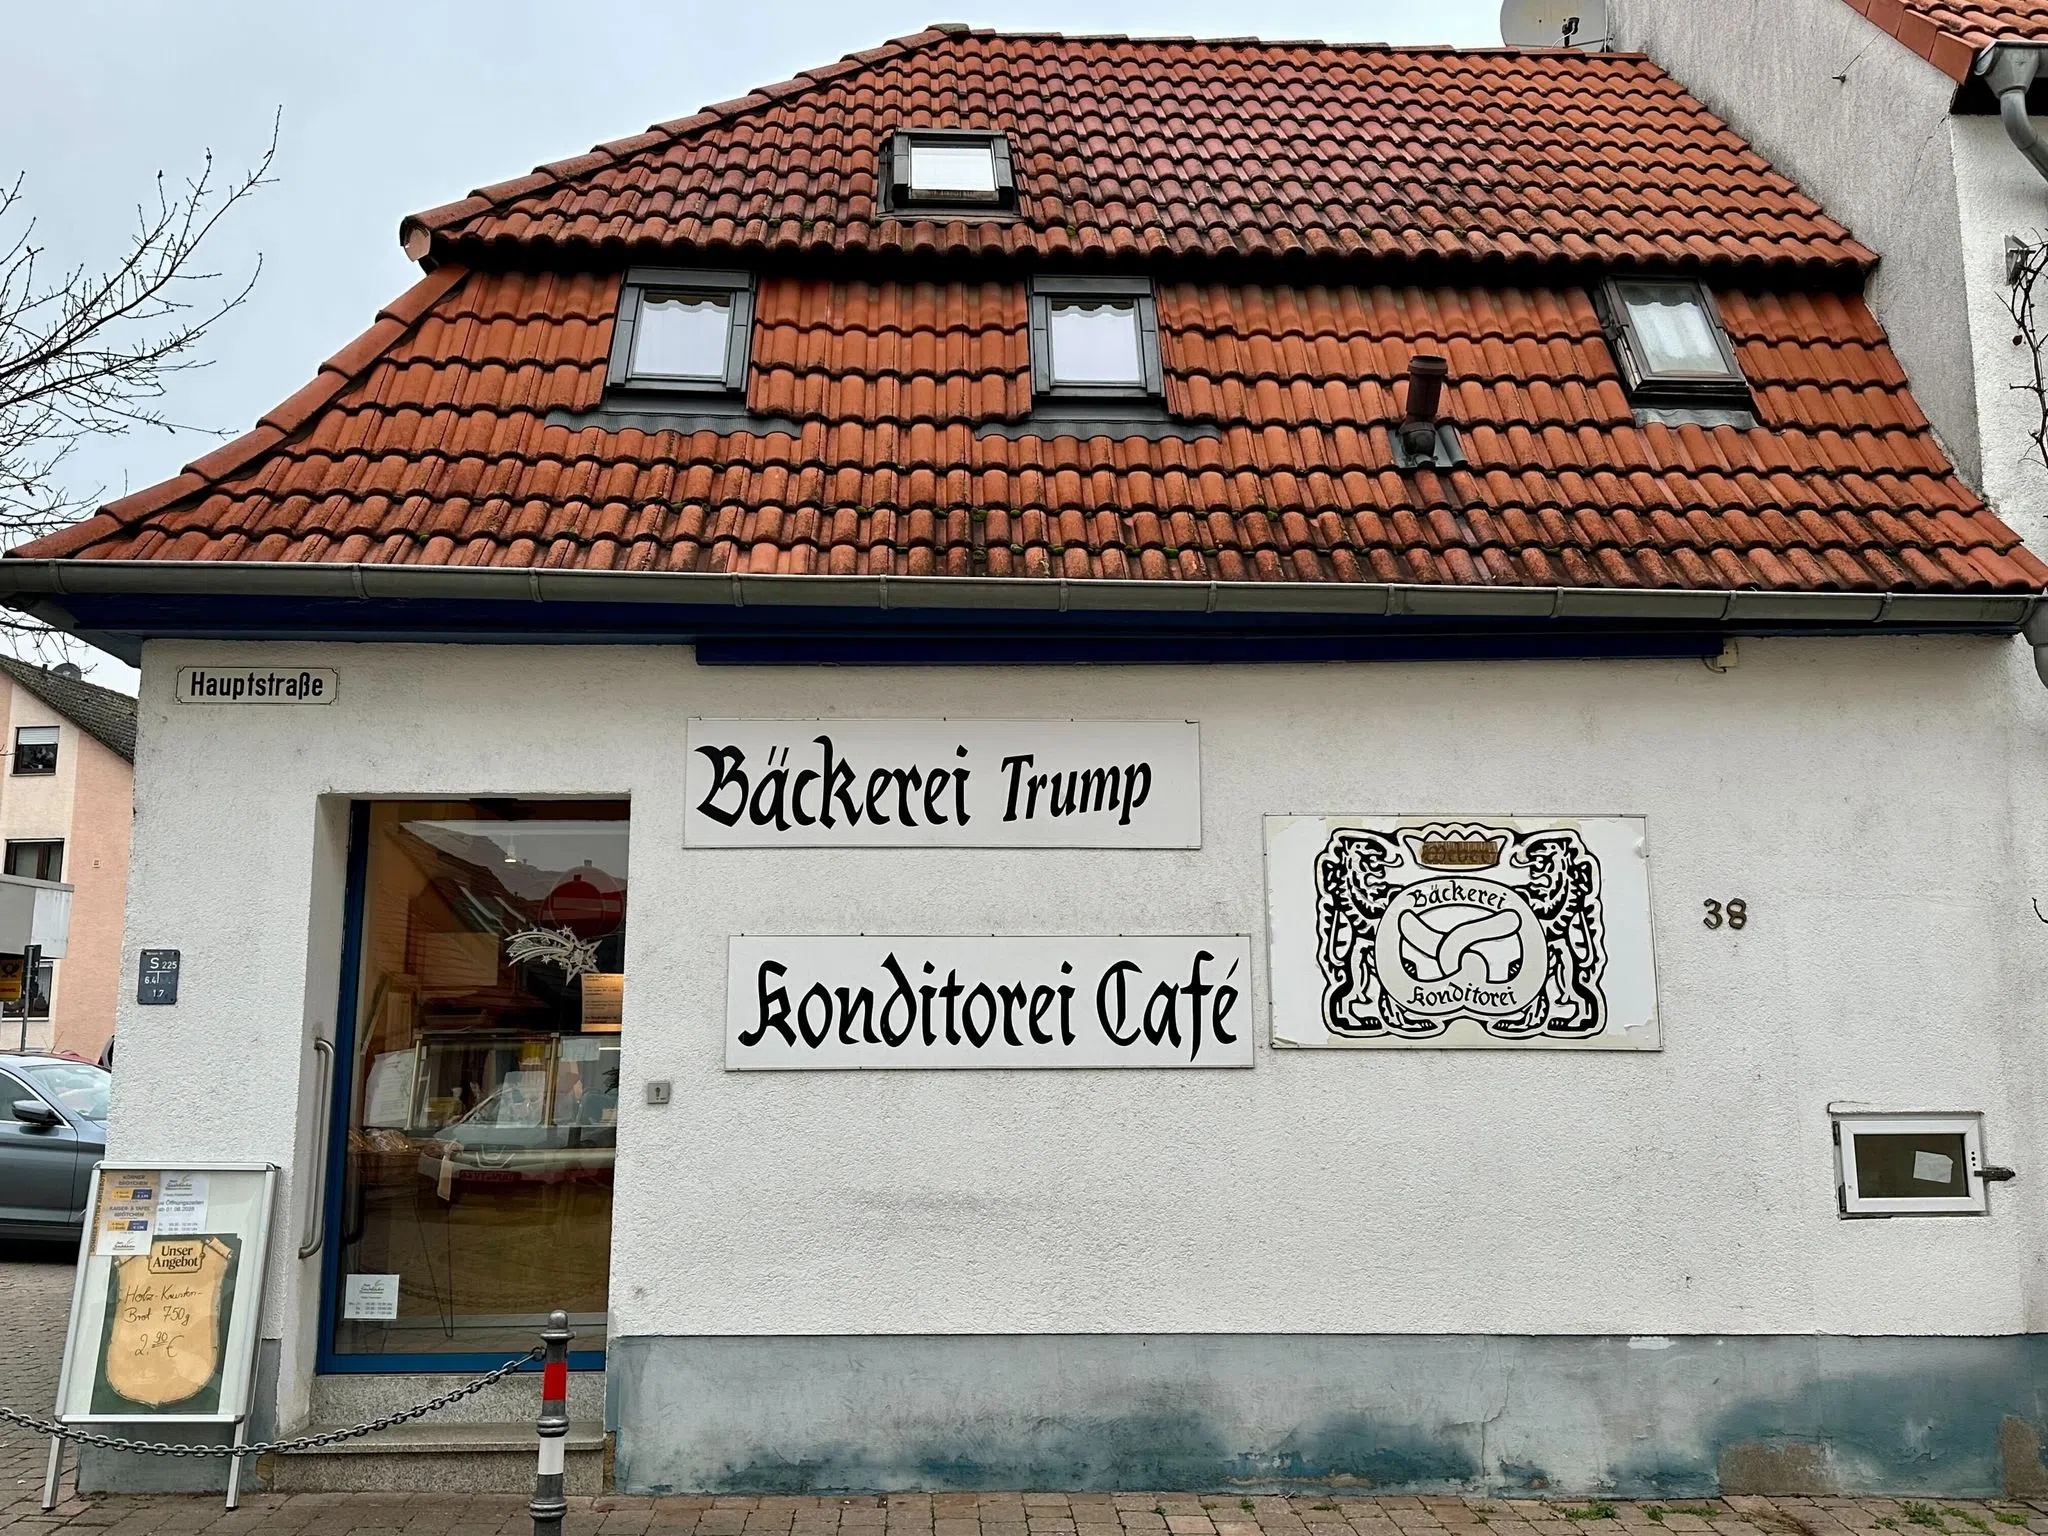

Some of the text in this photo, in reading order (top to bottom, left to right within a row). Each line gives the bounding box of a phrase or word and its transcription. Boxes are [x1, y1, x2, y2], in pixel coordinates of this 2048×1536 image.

[191, 671, 323, 700] Hauptstraße
[694, 735, 1152, 831] Bäckerei Trump
[1406, 880, 1507, 909] Bäckerei
[1703, 898, 1747, 929] 38
[150, 957, 178, 970] S 225
[738, 951, 1077, 1049] Konditorei
[1097, 950, 1240, 1062] Café
[1406, 981, 1518, 1007] Konditorei
[153, 1257, 199, 1270] Angebot
[161, 1245, 193, 1257] Unser
[124, 1306, 190, 1326] Brot 750g
